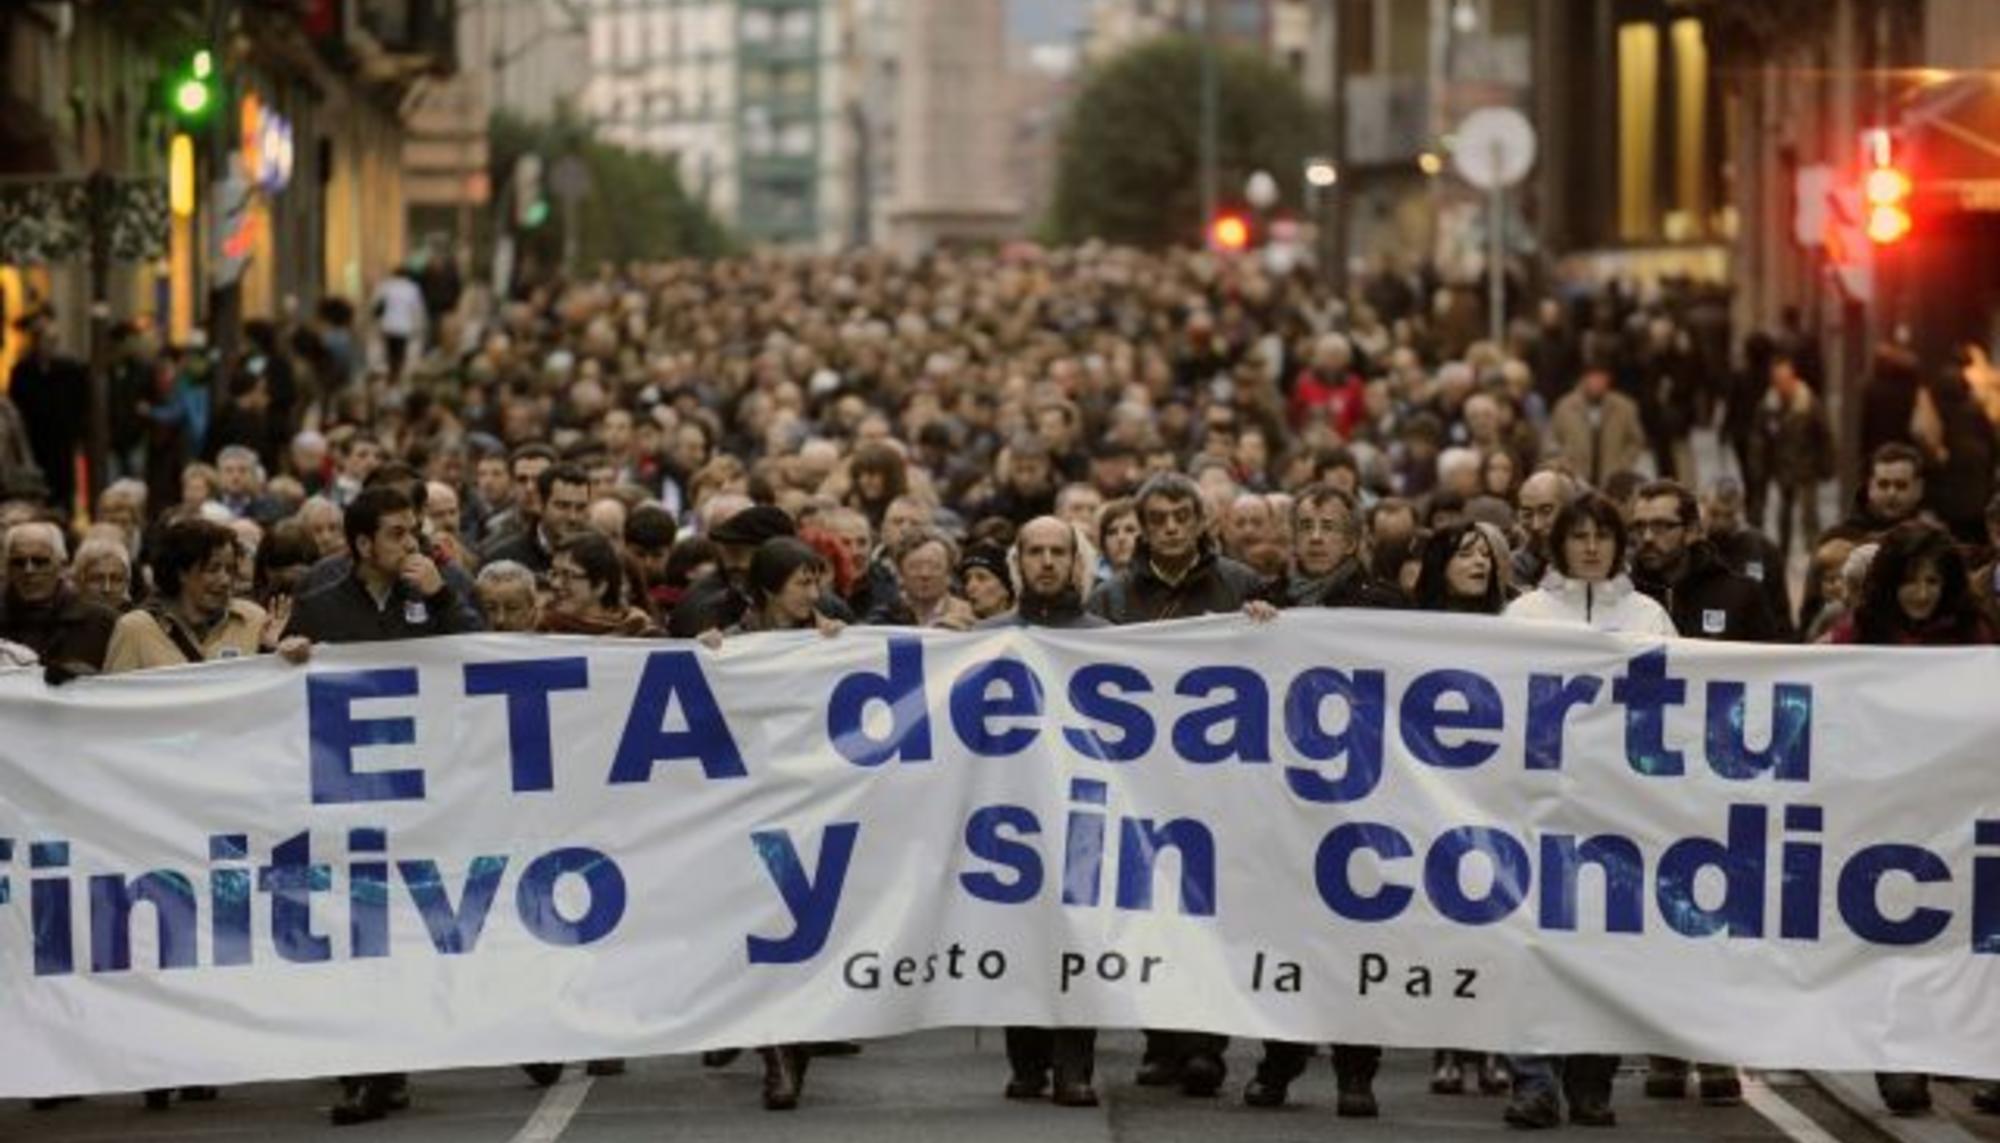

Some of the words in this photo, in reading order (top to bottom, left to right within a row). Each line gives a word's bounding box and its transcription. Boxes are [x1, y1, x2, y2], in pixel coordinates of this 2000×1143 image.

[307, 652, 748, 803] ETA
[827, 637, 1812, 803] desagertu
[0, 828, 627, 976] initivo
[746, 823, 859, 963] y
[959, 778, 1216, 916] sin
[1314, 804, 2000, 953] condici
[843, 943, 1007, 990] Gesto
[1060, 951, 1163, 993] por
[1252, 952, 1302, 993] la
